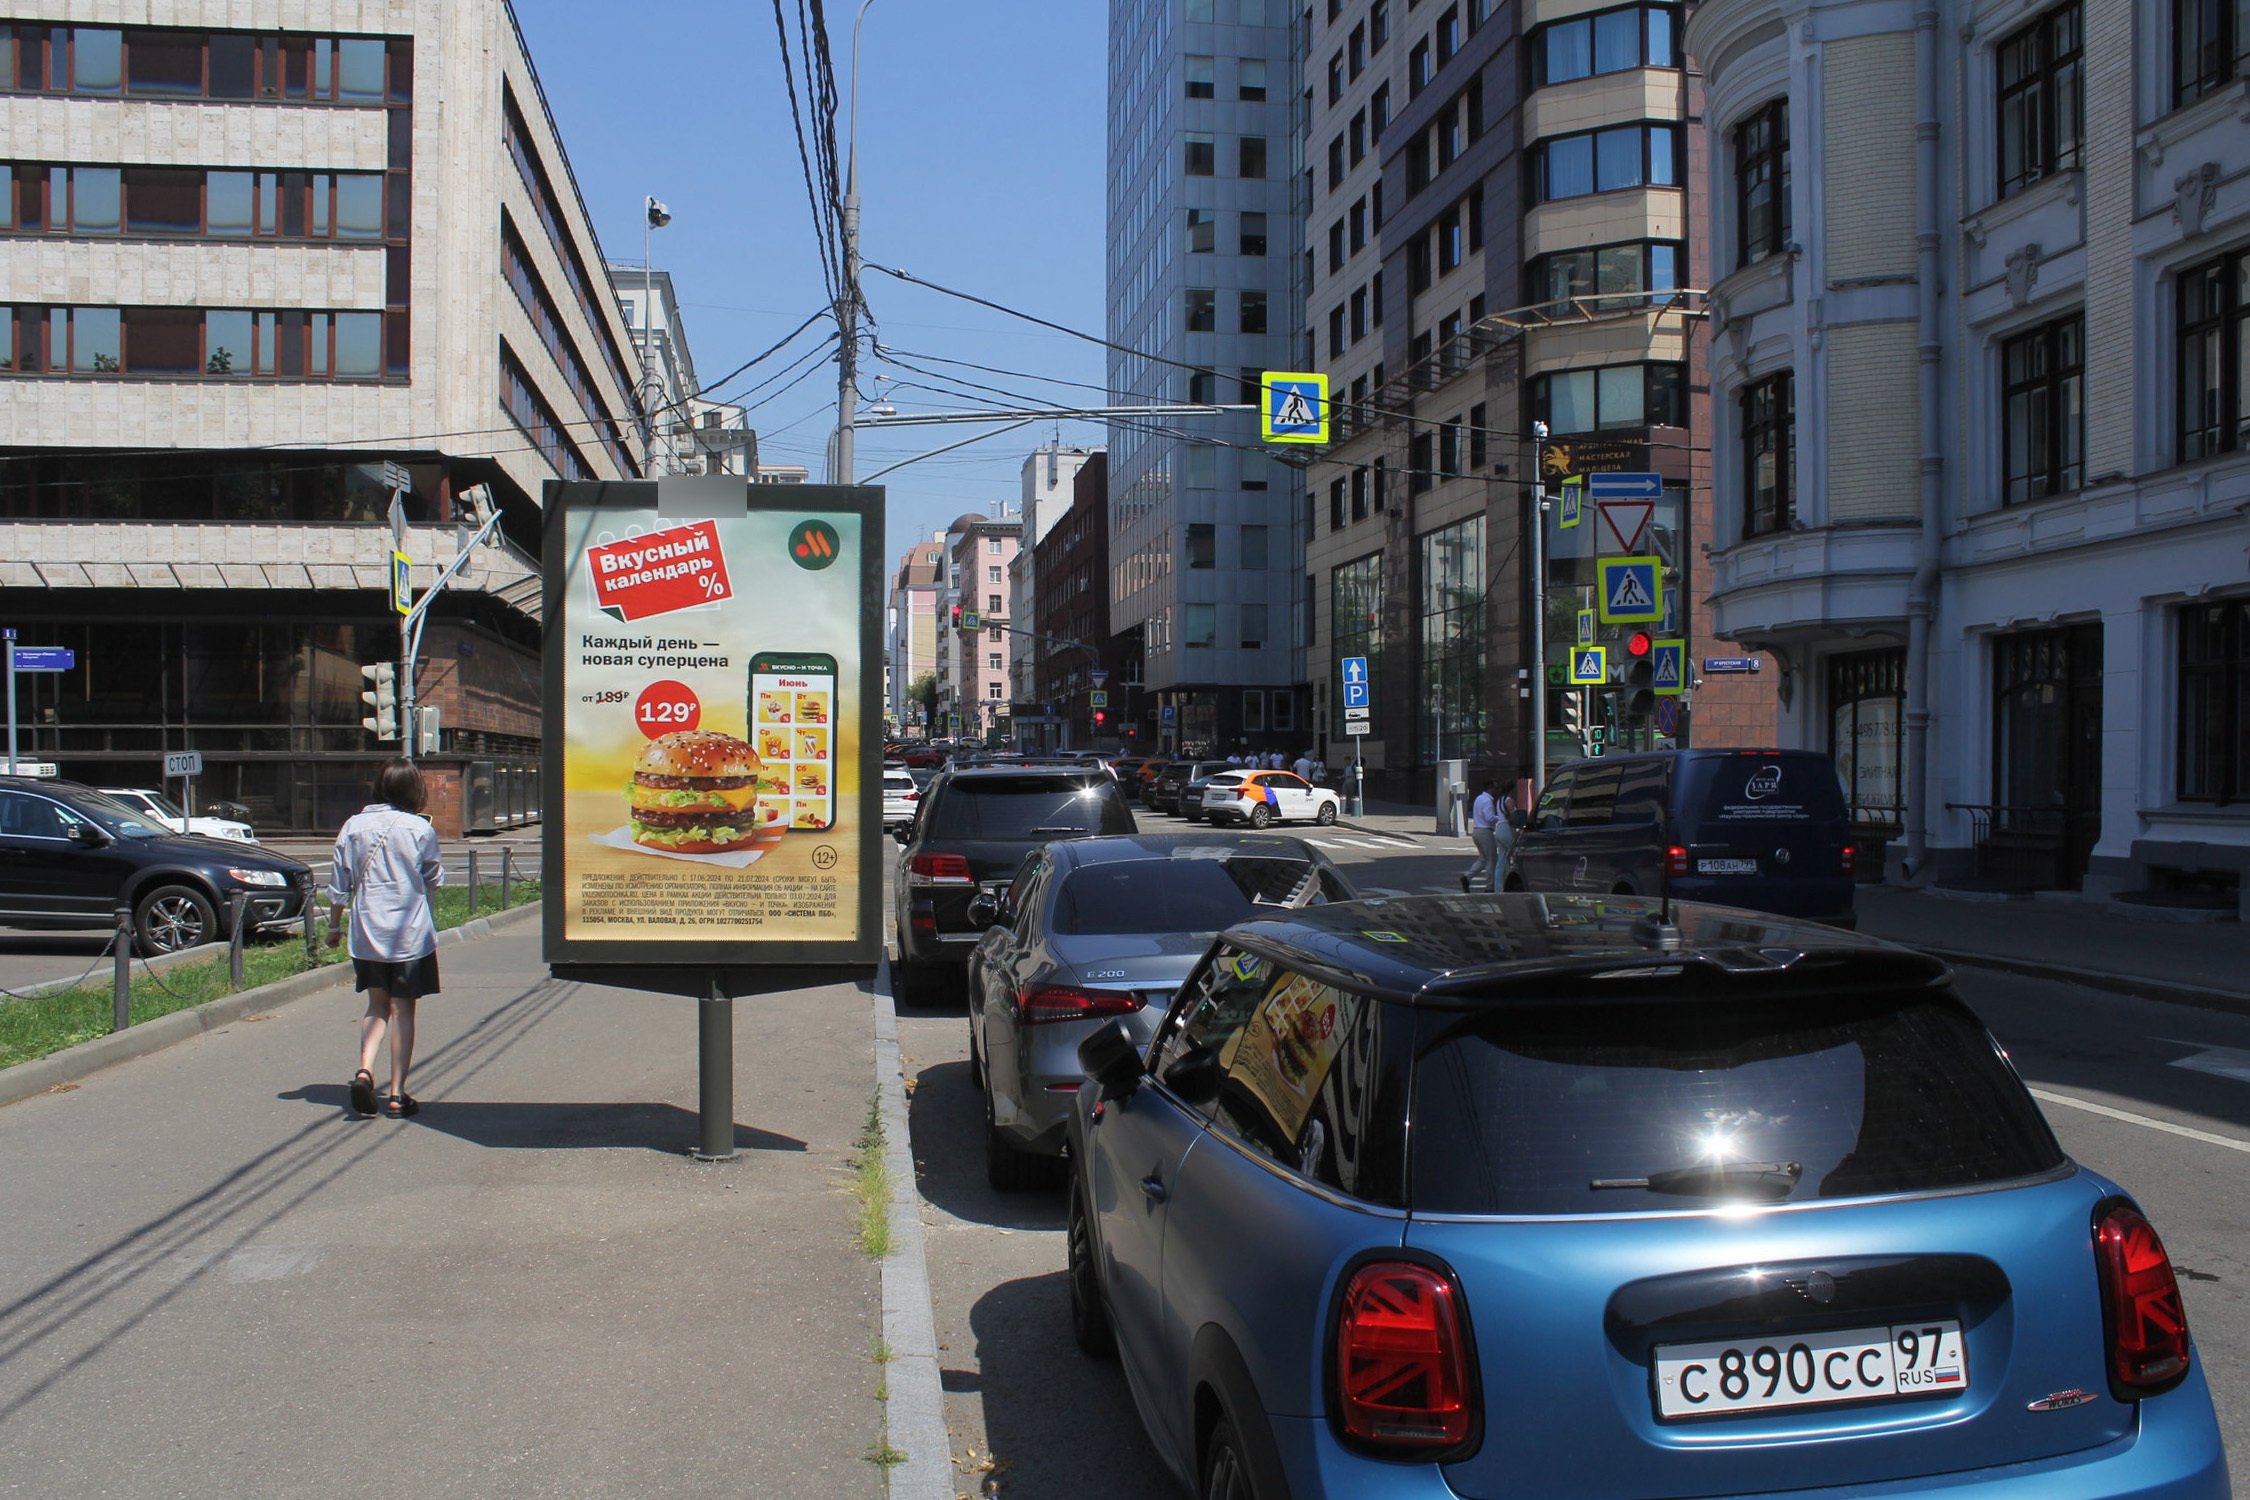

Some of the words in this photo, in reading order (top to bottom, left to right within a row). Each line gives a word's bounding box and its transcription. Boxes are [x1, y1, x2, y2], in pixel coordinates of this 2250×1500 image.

[600, 531, 710, 573] Вкусный
[605, 557, 713, 591] календарь
[699, 572, 724, 598] %
[583, 635, 652, 650] Каждый
[657, 639, 698, 651] день
[583, 656, 633, 666] новая
[638, 656, 728, 669] суперцена
[1754, 660, 1759, 668] 8
[1350, 686, 1363, 704] P
[169, 755, 195, 771] СТОП
[817, 852, 835, 863] 12+
[1898, 1327, 1942, 1369] 97
[1899, 1370, 1933, 1386] RUS
[2048, 1396, 2082, 1408] WORKS
